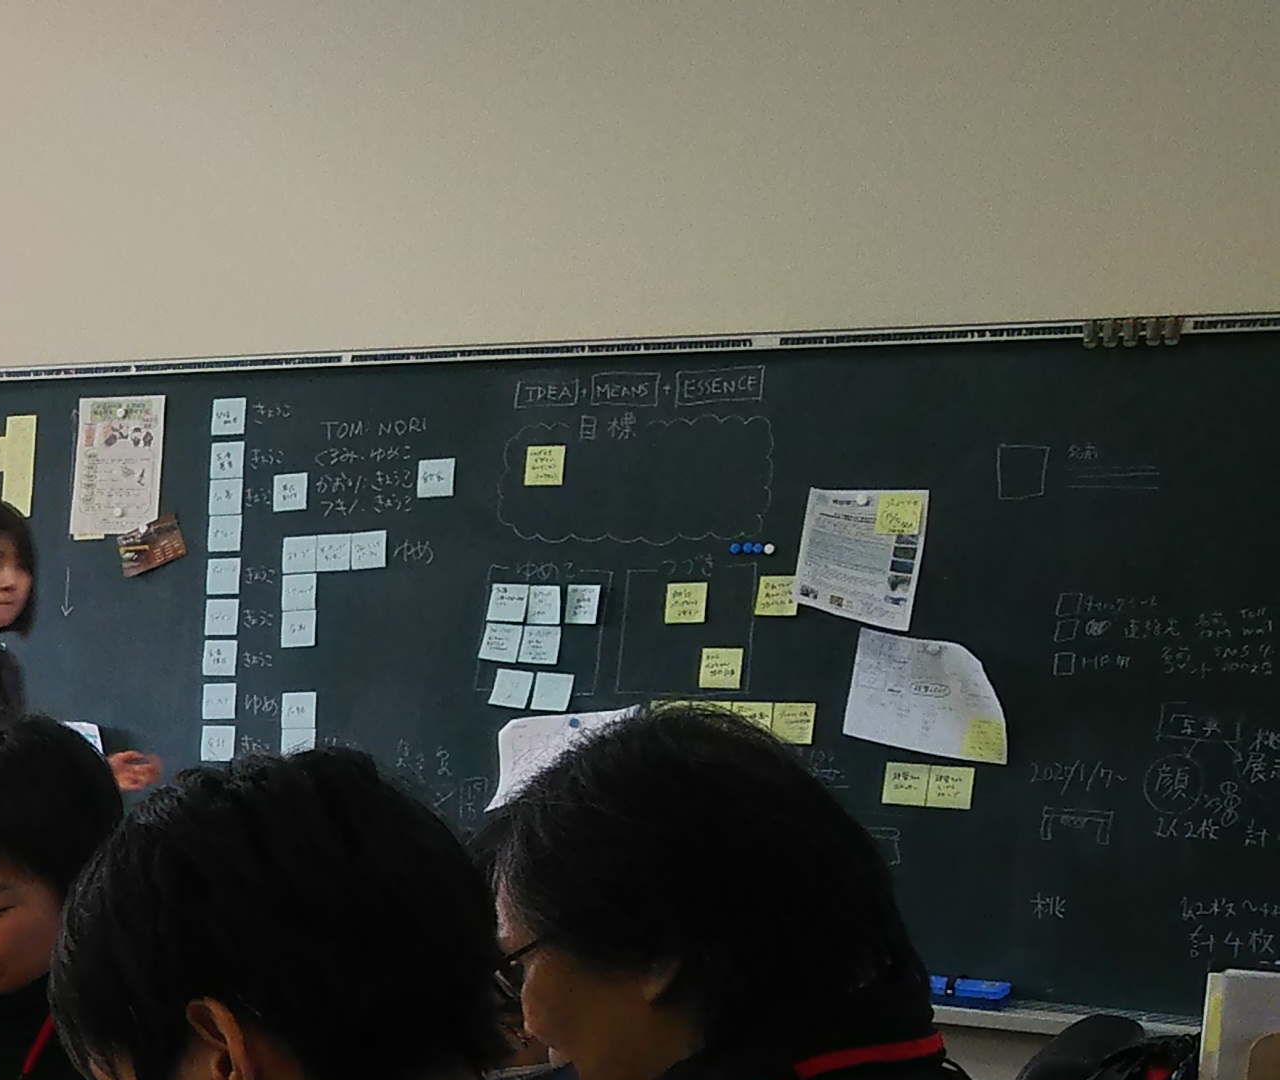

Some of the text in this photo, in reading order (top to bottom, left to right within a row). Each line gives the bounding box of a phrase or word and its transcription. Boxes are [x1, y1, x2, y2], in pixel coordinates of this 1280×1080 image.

[525, 375, 758, 399] IDEA MEANS ESSENCE
[580, 411, 637, 440] 目標
[1154, 763, 1191, 800] 顔
